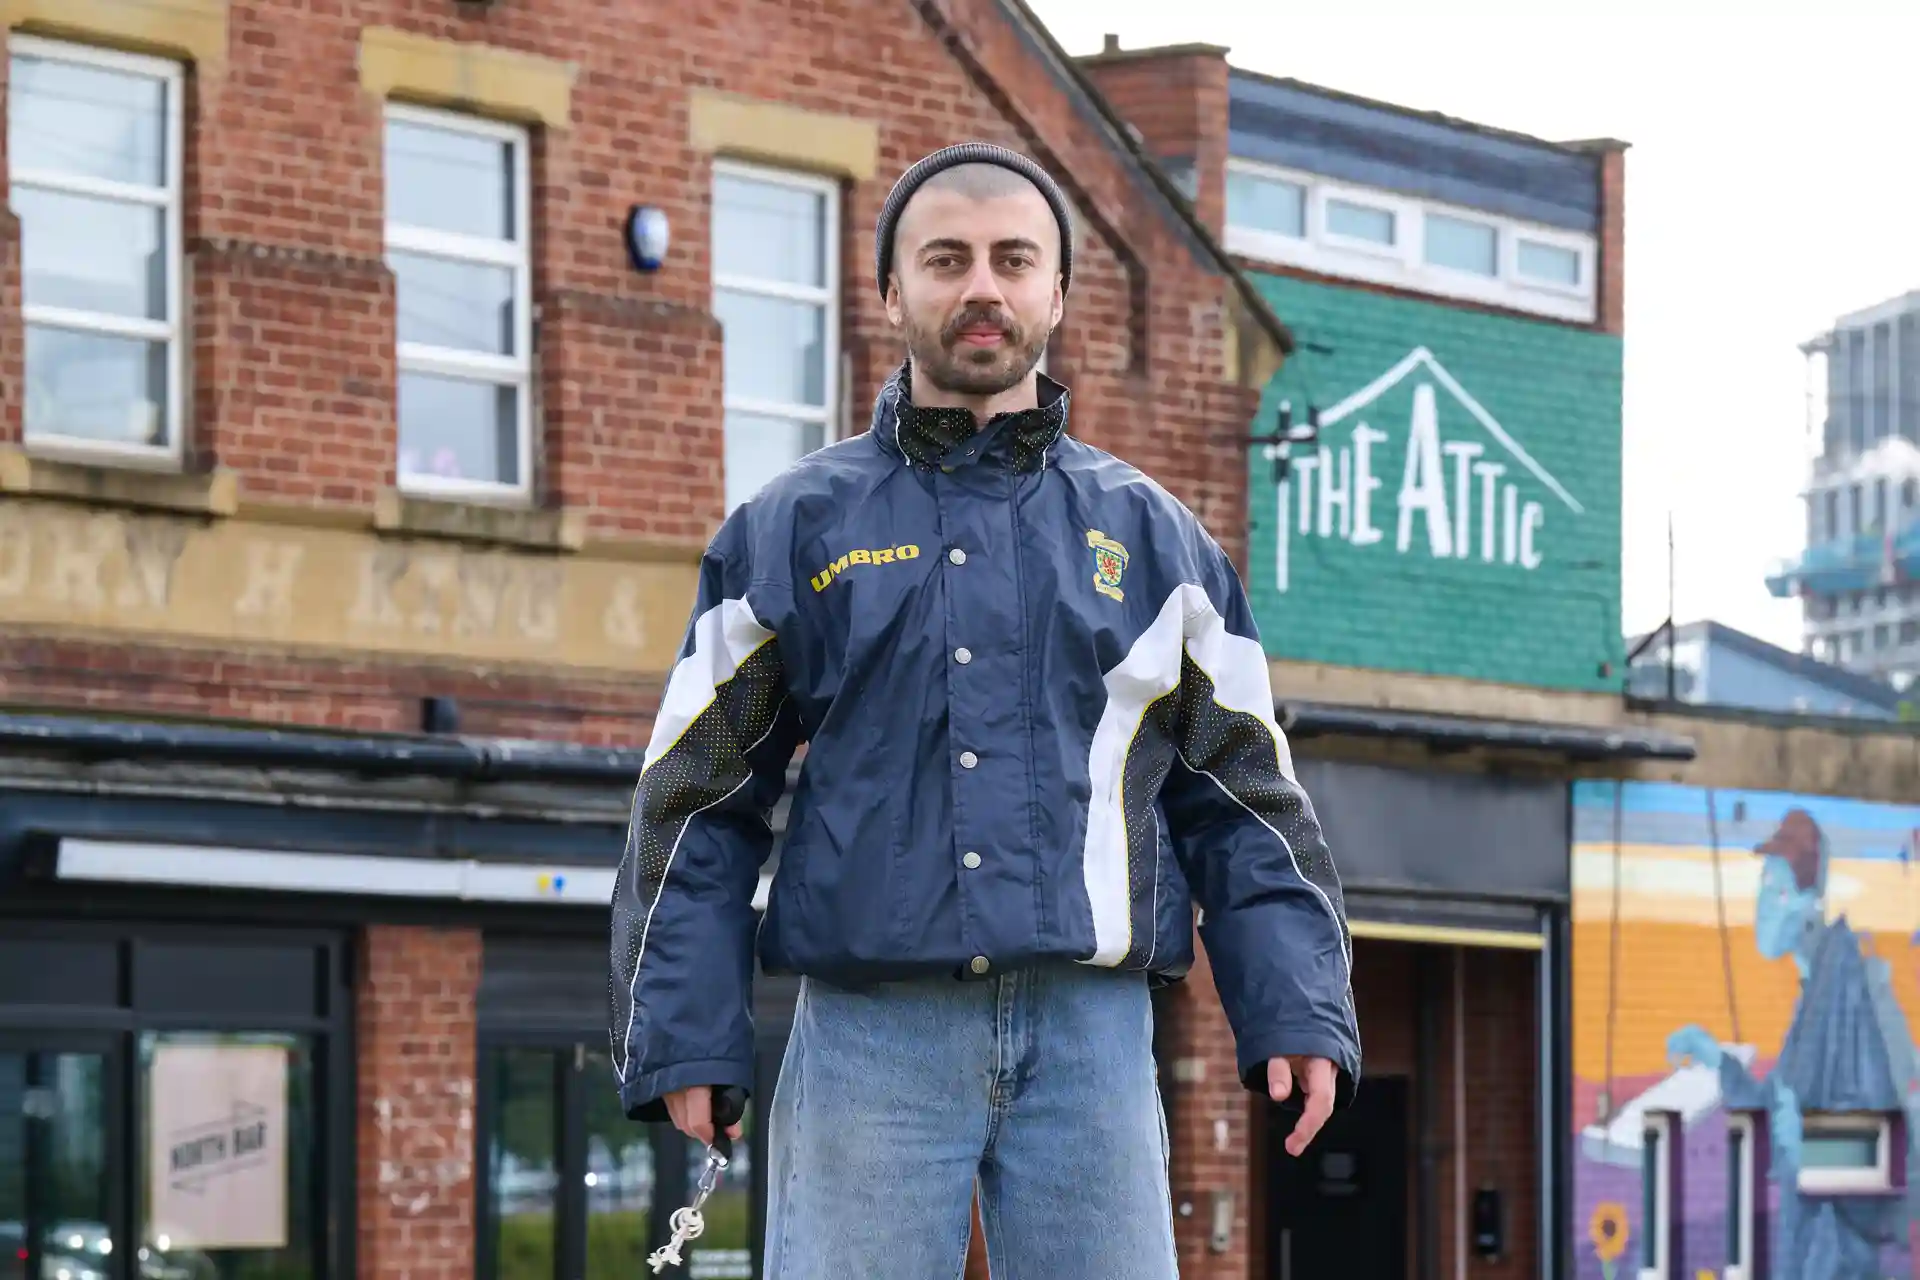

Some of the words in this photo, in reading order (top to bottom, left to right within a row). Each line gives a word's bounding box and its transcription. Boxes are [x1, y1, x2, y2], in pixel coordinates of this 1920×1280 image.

[1292, 420, 1389, 546] THE
[1396, 383, 1544, 570] ATTIC
[810, 544, 920, 593] UMBRO
